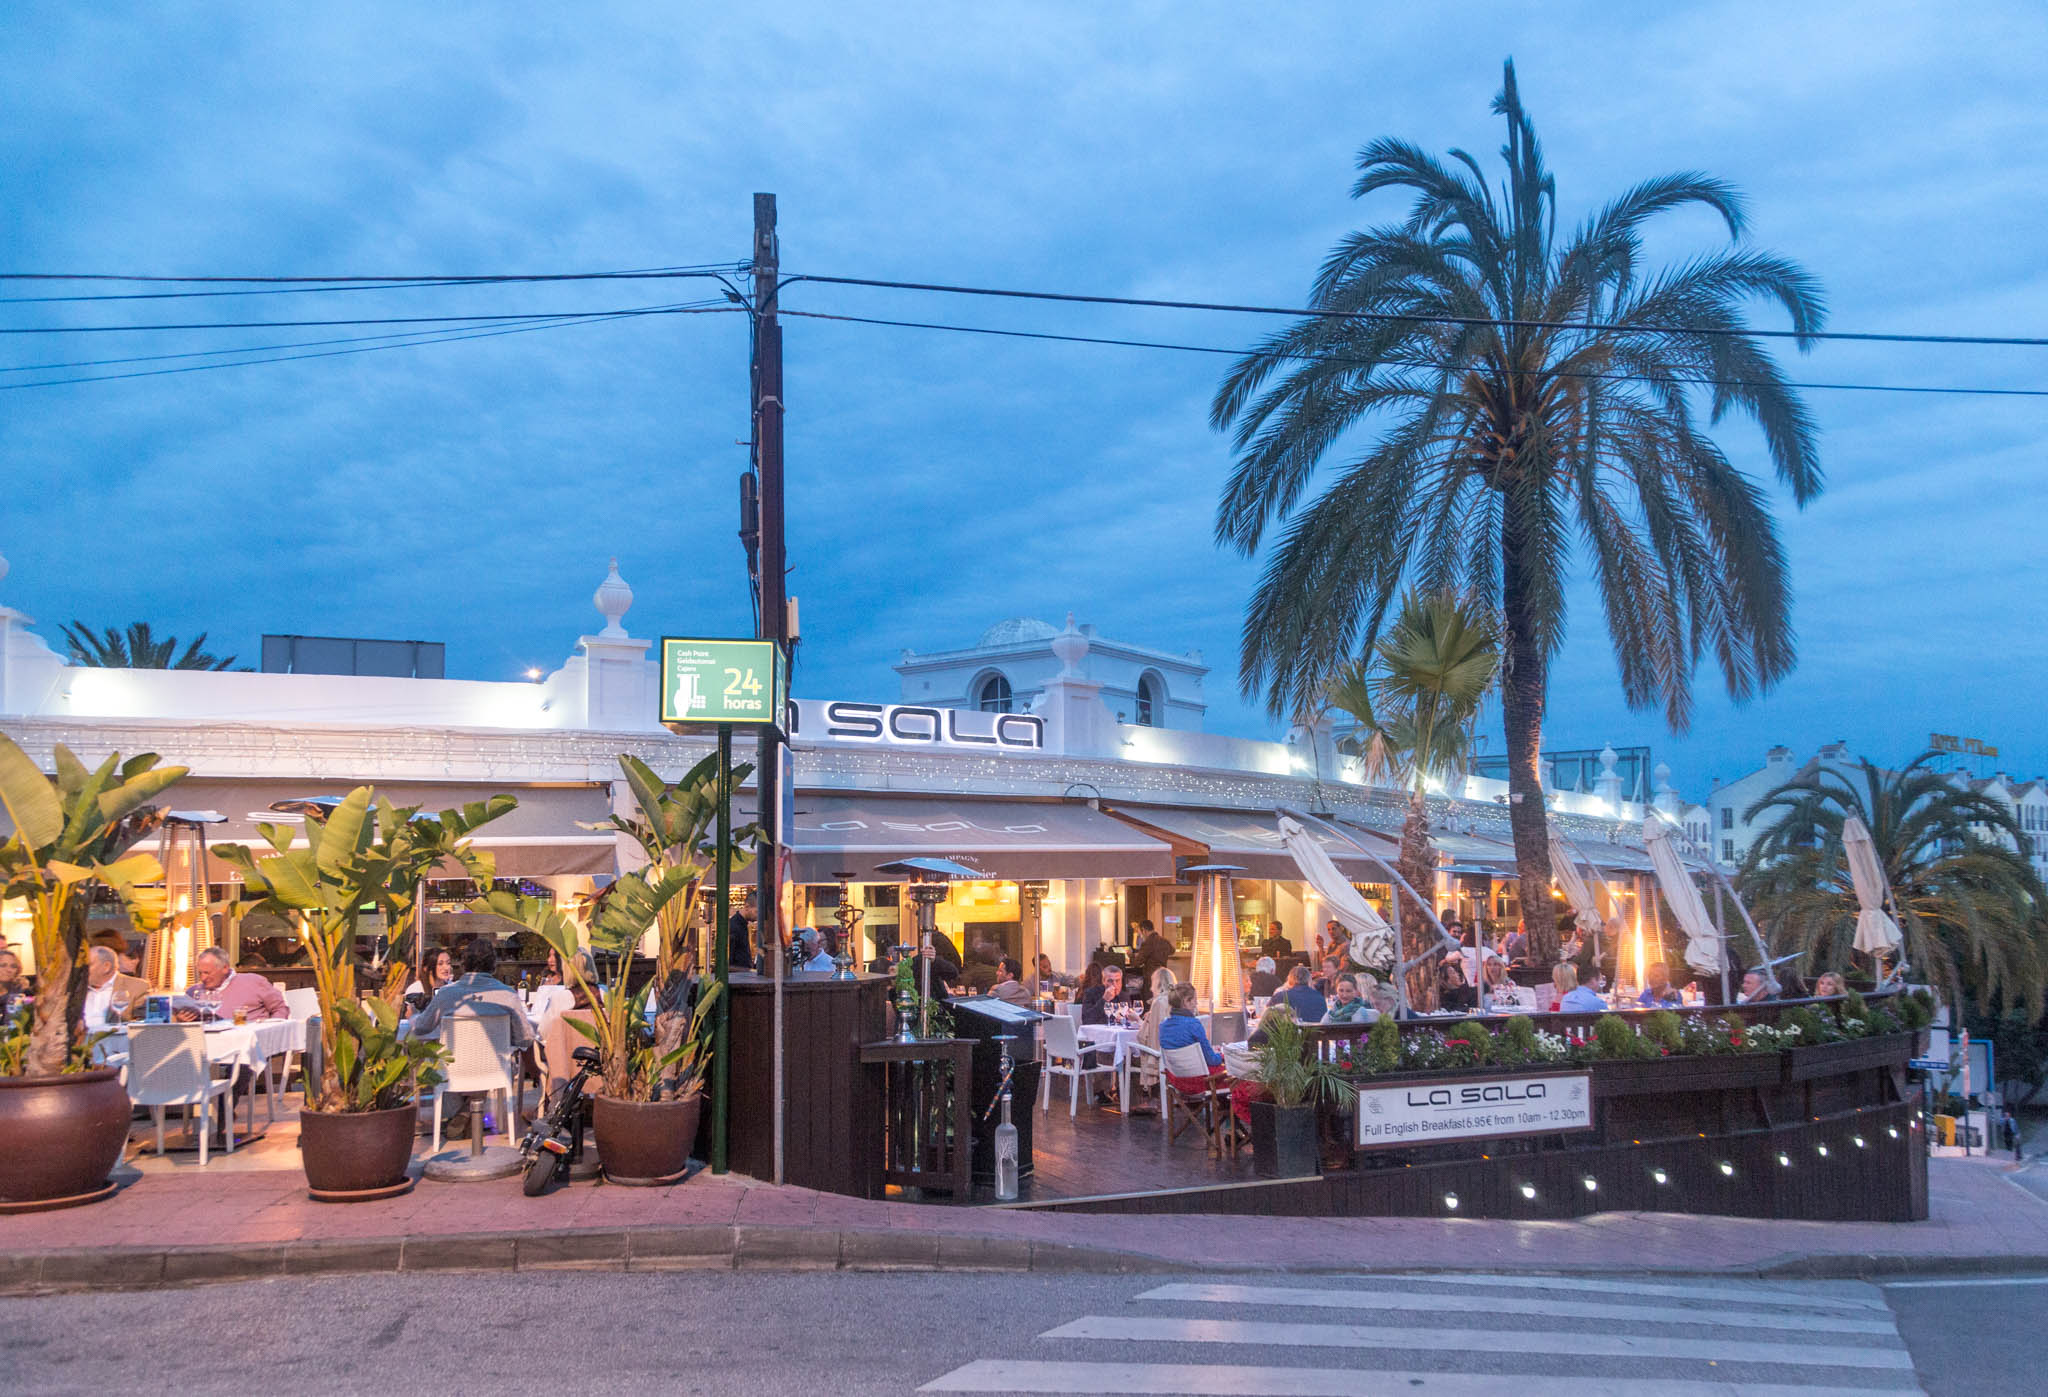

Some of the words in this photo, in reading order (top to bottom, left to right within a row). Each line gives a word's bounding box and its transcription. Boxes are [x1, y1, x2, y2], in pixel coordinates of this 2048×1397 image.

[724, 668, 763, 696] 24
[724, 695, 762, 710] horas
[1365, 1124, 1382, 1136] Full
[1385, 1122, 1419, 1136] English
[1421, 1118, 1465, 1132] Breakfast
[1494, 1114, 1514, 1125] from
[1518, 1112, 1541, 1123] 10am
[1550, 1109, 1585, 1121] 12.30pm
